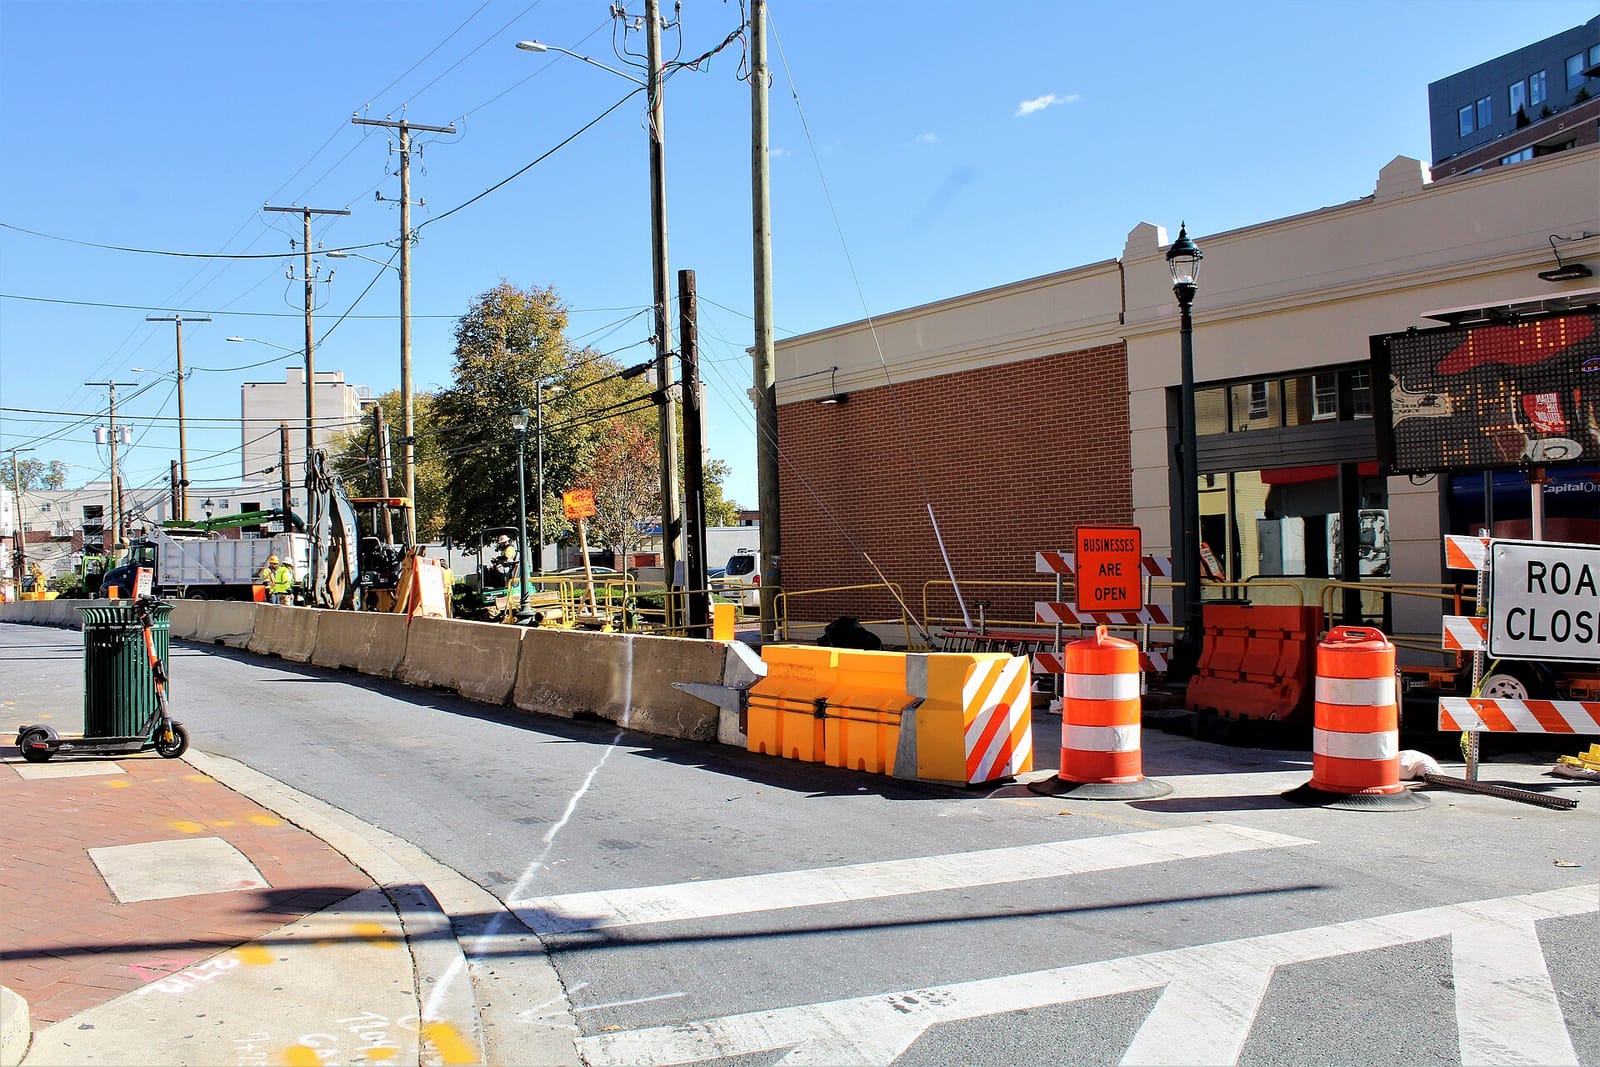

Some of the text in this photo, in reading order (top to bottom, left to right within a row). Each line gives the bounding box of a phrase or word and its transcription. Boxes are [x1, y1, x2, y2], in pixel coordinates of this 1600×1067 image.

[1083, 539, 1135, 553] BUSINESSES
[1098, 562, 1123, 577] ARE
[1094, 587, 1127, 601] OPEN
[1506, 607, 1600, 643] CLOS
